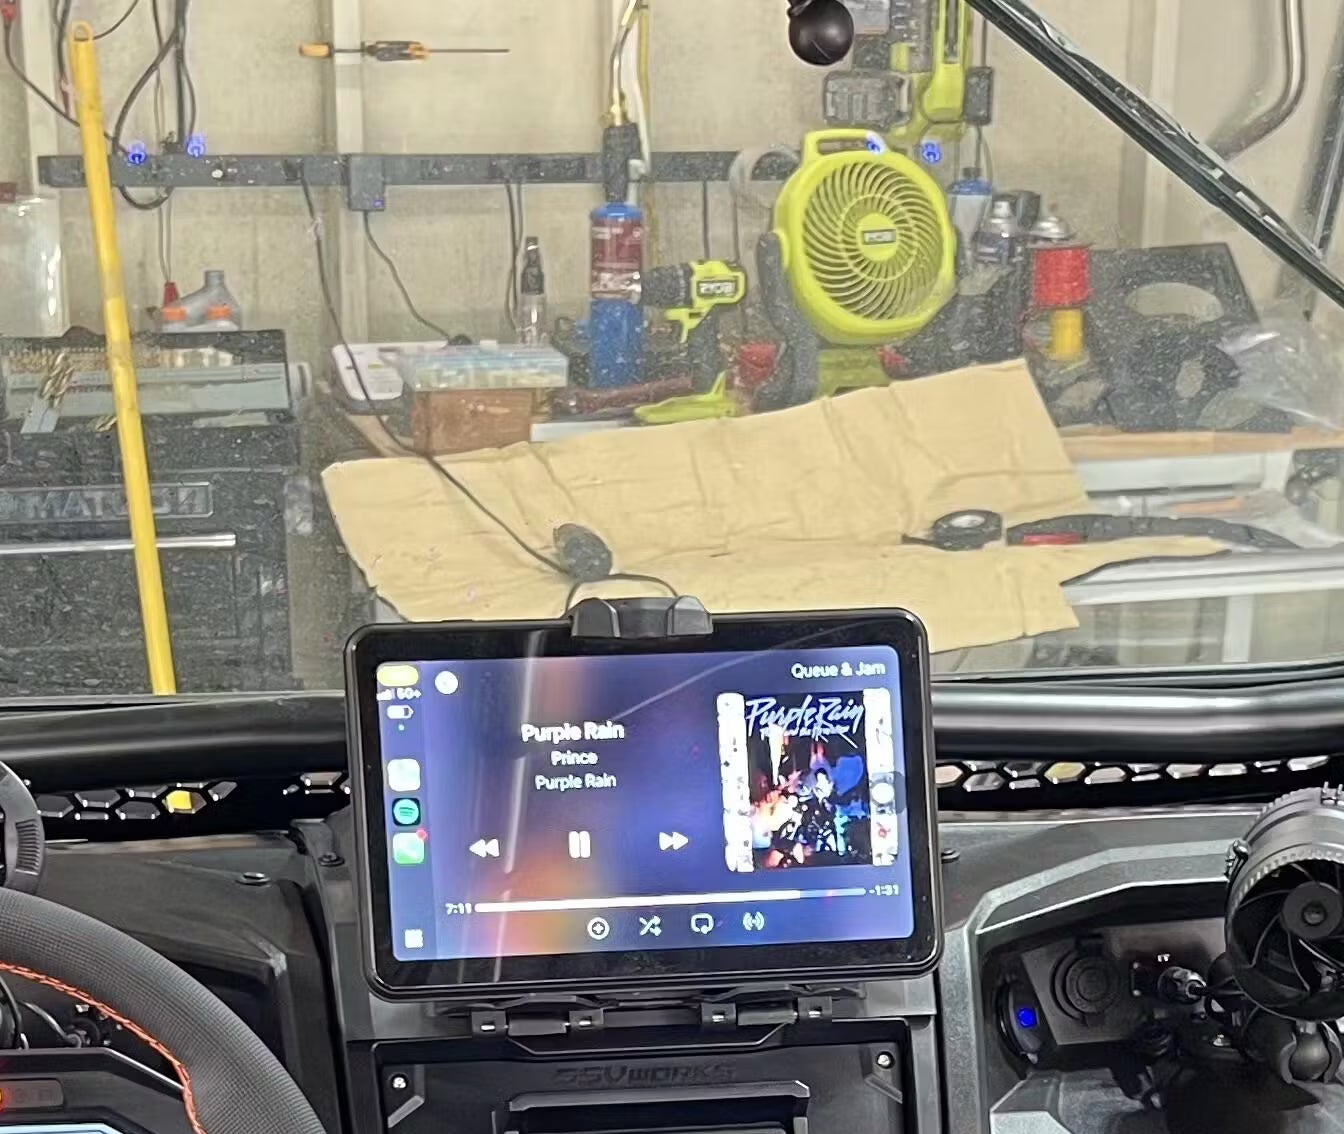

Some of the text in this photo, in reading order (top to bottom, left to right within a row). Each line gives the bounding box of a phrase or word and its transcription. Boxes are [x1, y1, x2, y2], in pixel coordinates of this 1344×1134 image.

[791, 661, 886, 678] Queue & Jam
[521, 720, 624, 744] Purple Rain
[551, 750, 598, 766] Prince
[535, 772, 616, 791] Purple Rain
